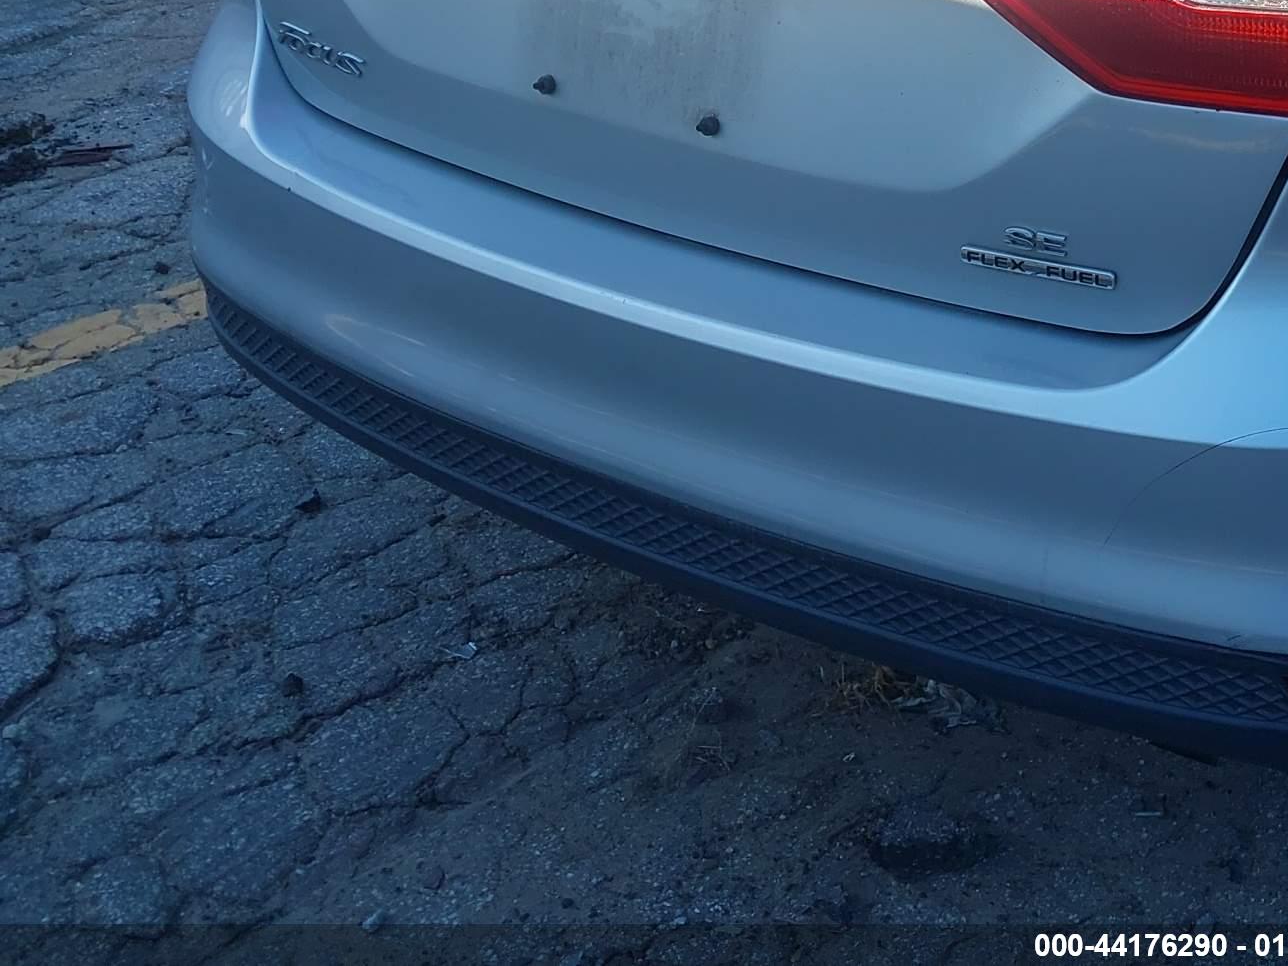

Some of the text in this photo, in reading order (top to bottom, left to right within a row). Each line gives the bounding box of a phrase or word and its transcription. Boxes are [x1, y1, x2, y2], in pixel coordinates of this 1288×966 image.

[1004, 226, 1068, 257] SE
[966, 251, 1112, 288] FLEX FUEL
